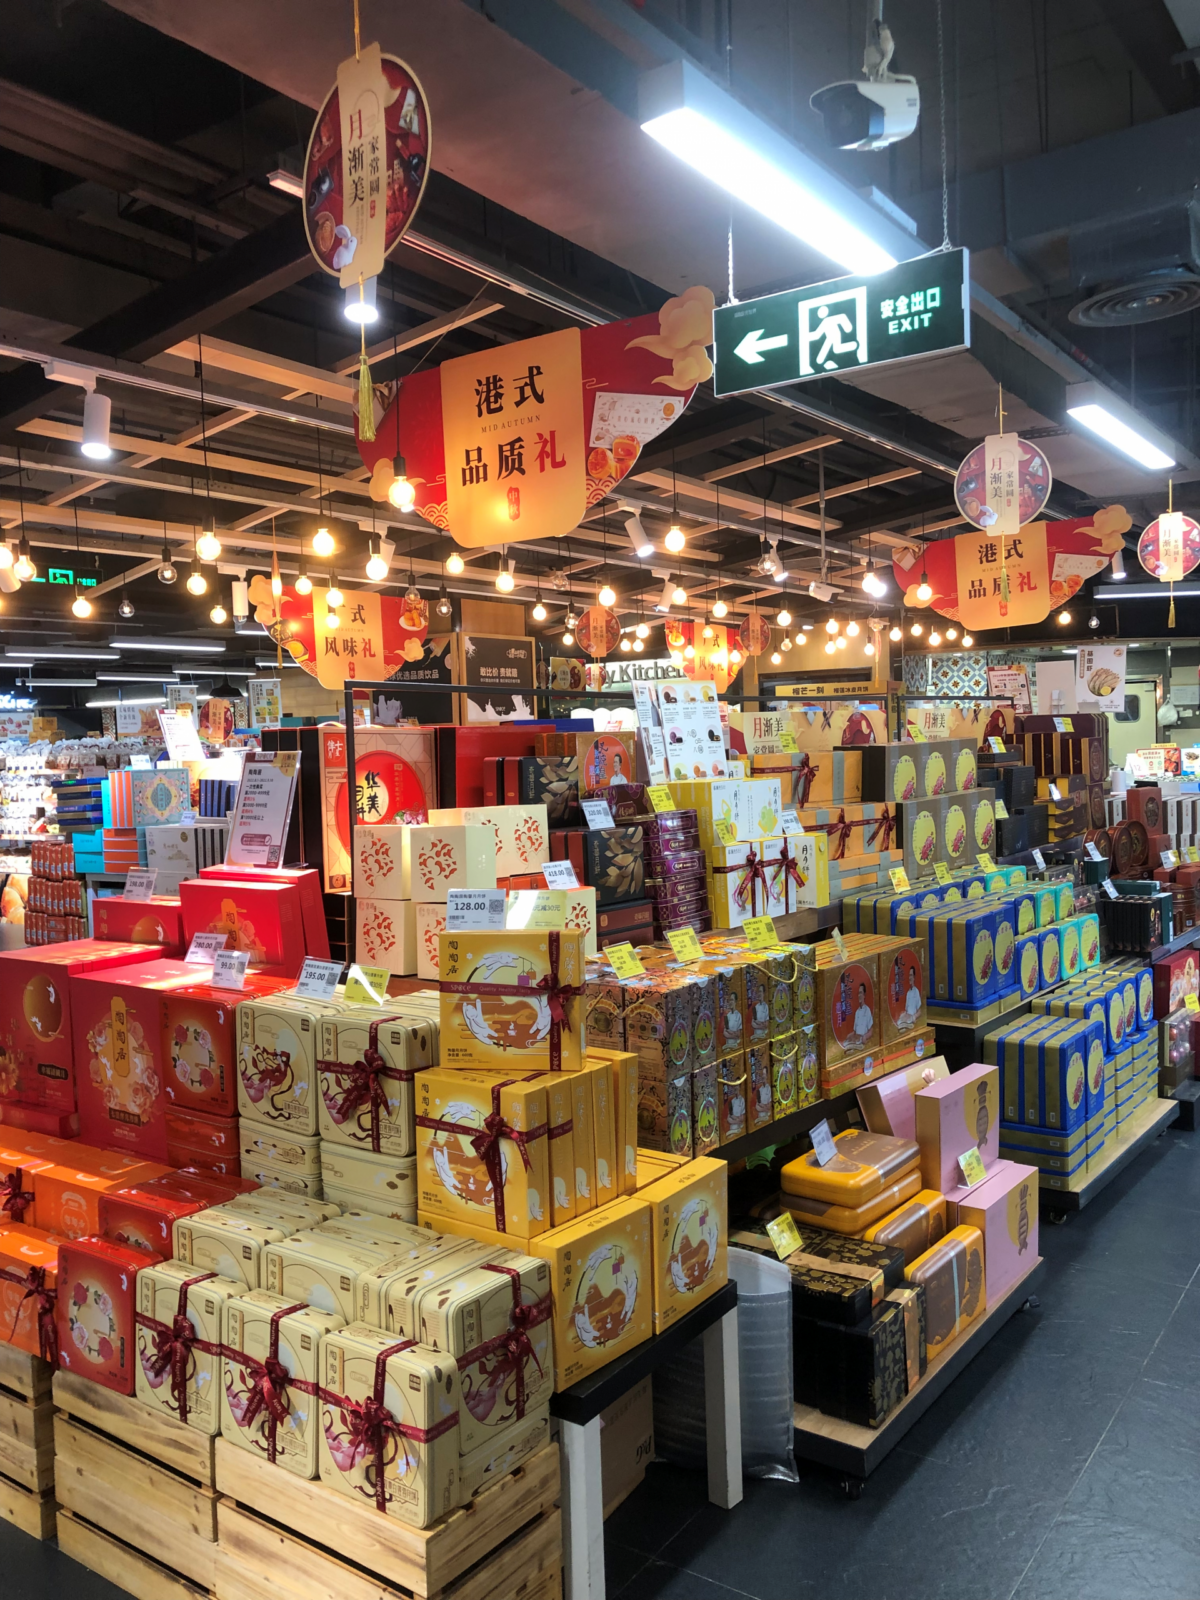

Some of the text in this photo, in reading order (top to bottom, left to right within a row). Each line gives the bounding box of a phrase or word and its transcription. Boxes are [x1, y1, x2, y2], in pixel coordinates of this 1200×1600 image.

[348, 109, 365, 207] 月渐美
[880, 286, 941, 319] 安全出口
[888, 312, 932, 335] EXIT
[474, 365, 545, 418] 港式
[481, 415, 541, 434] MID AUTUMN
[461, 430, 567, 487] 品质礼
[990, 457, 1003, 498] 月渐美
[978, 539, 1024, 565] 港式
[324, 636, 376, 658] 风味礼
[480, 666, 499, 677] 敢比价
[792, 686, 824, 695] 榴芒一刻
[753, 716, 784, 739] 月渐美
[924, 712, 946, 730] 月渐美
[365, 770, 382, 817] 华美
[454, 902, 486, 911] 128.00
[194, 941, 213, 949] 280.00
[446, 940, 459, 976] 陶陶居
[220, 962, 236, 970] 99.00
[304, 971, 326, 981] 195.00
[115, 1010, 126, 1062] 陶陶居
[421, 1083, 430, 1117] 陶陶居
[327, 1349, 338, 1386] 陶陶居
[636, 1434, 653, 1465] P&G
